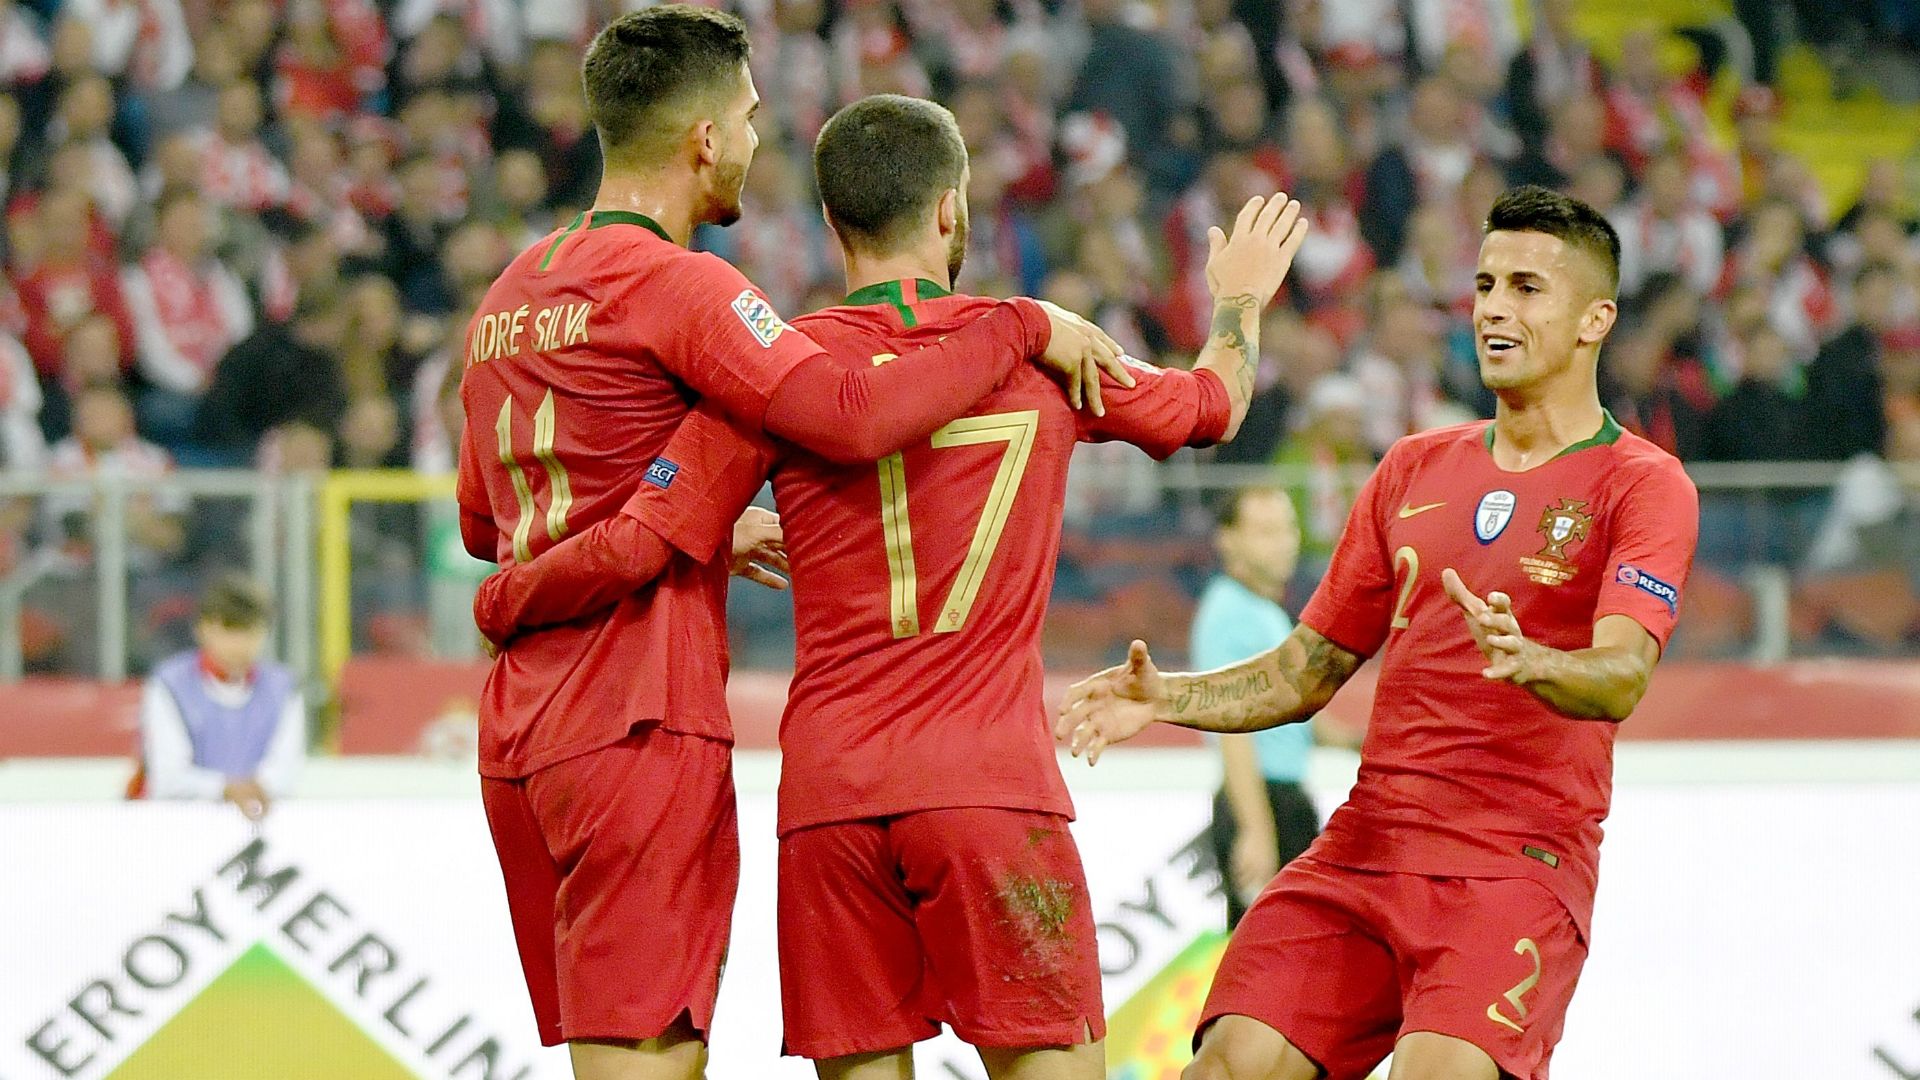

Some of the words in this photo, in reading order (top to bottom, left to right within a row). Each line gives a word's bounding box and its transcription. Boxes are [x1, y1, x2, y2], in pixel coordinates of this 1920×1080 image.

[467, 304, 530, 369] NDRÉ
[531, 302, 592, 352] SILVA
[495, 386, 573, 563] 11
[646, 463, 676, 482] PECT
[877, 410, 1040, 639] 17
[1391, 546, 1419, 629] 2
[25, 889, 227, 1077] EROY
[1503, 937, 1541, 1020] 2
